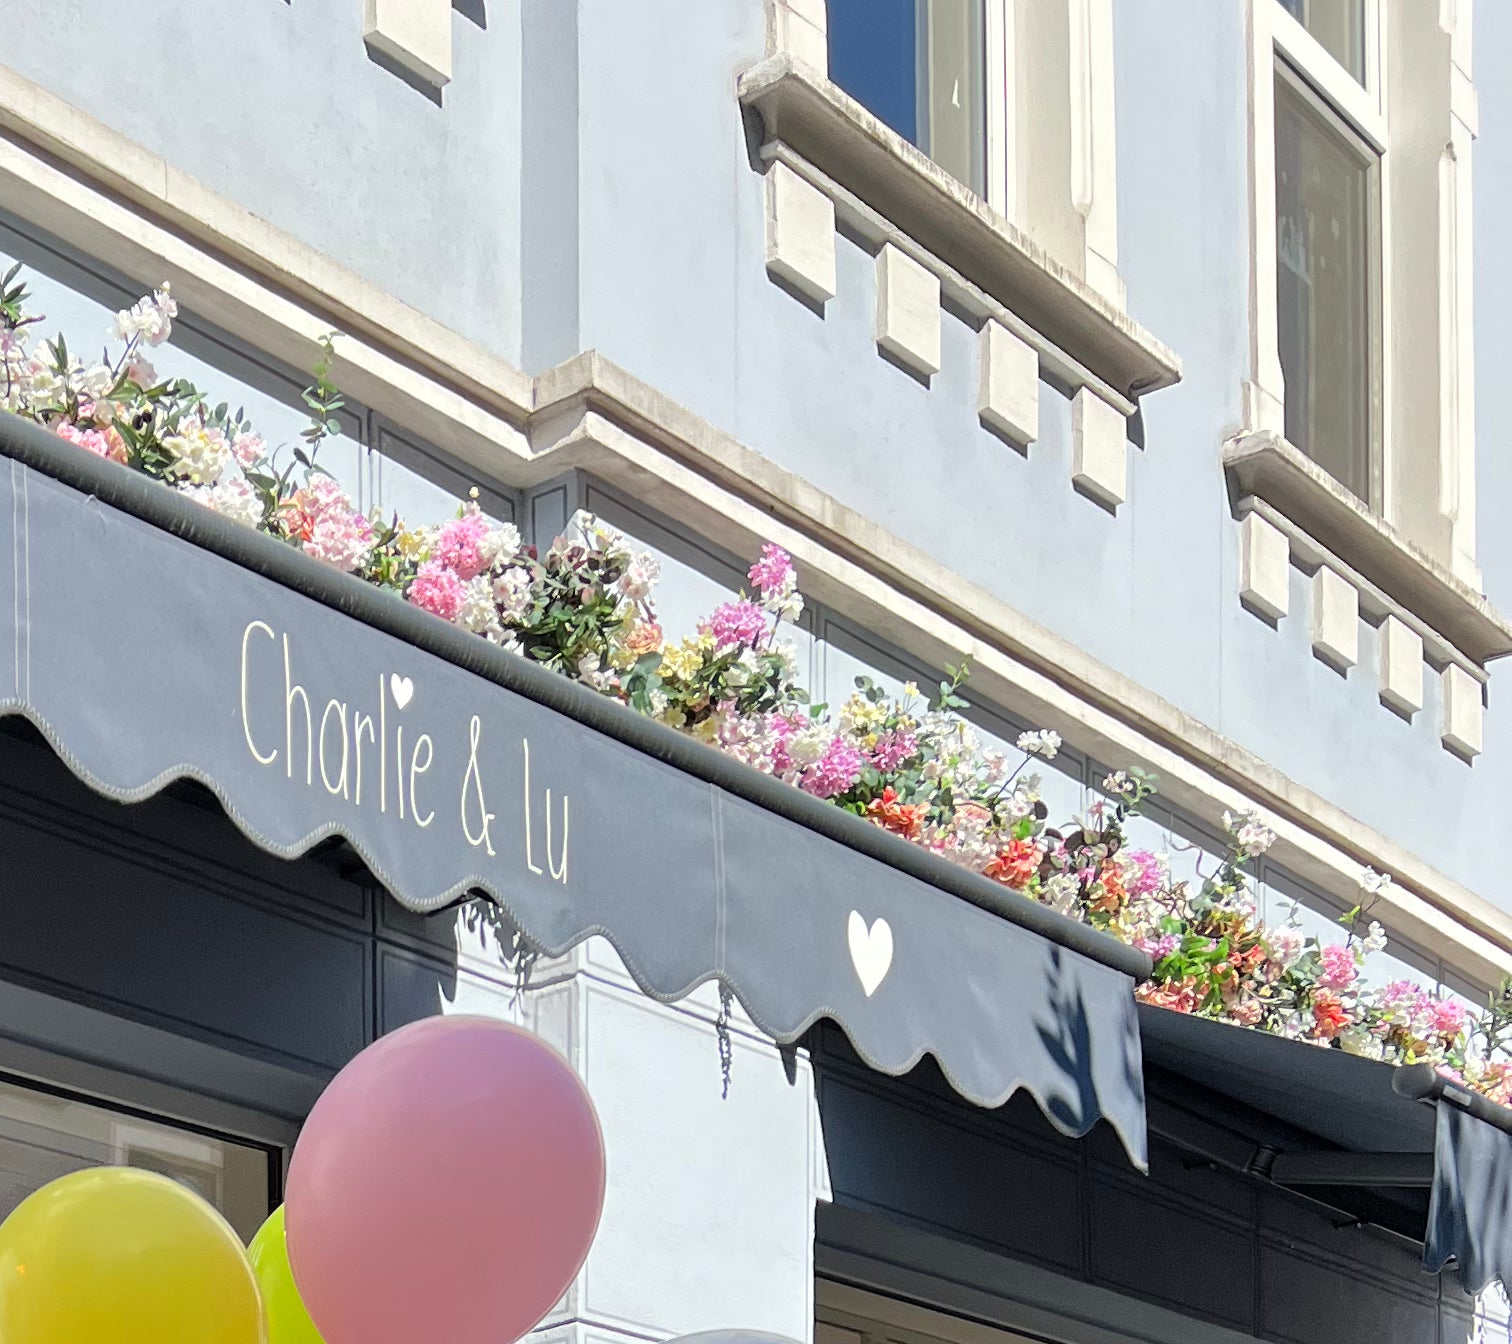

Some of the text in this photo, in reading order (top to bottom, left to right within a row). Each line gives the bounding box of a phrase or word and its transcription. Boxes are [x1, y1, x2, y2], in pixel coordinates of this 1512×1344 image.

[241, 619, 569, 884] Charlie & Lu
